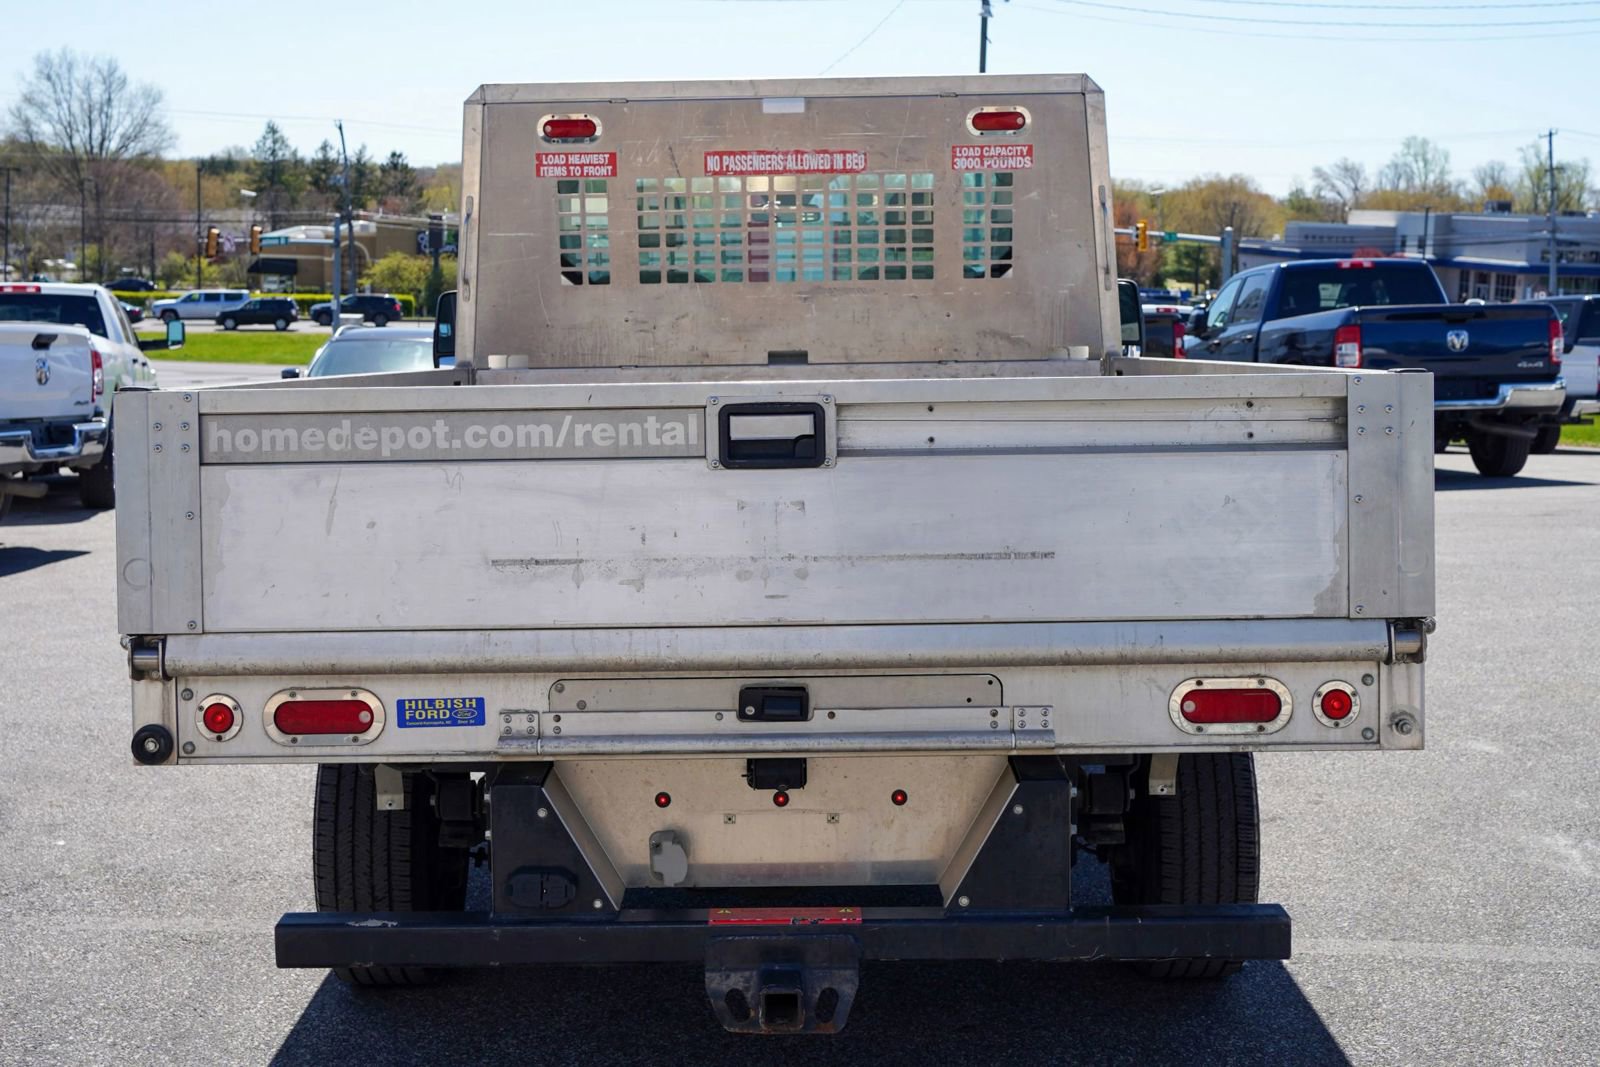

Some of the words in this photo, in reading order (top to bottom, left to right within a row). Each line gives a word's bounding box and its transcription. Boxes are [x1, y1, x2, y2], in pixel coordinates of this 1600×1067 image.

[956, 147, 980, 157] LOAD
[983, 146, 1028, 156] CAPACITY
[542, 154, 567, 164] LOAD
[568, 153, 610, 164] HEAVIEST
[706, 155, 720, 171] NO
[722, 154, 784, 171] PASSENGERS
[786, 153, 830, 170] ALLOWED
[833, 153, 843, 169] IN
[845, 153, 865, 169] BED
[953, 158, 980, 169] 3000
[983, 156, 1032, 168] POUNDS
[540, 166, 567, 176] ITEMS
[569, 166, 581, 176] TO
[583, 165, 612, 176] FRONT
[207, 414, 698, 457] homedepot.com/rental
[405, 699, 476, 709] HILBISH
[405, 709, 450, 720] FORD
